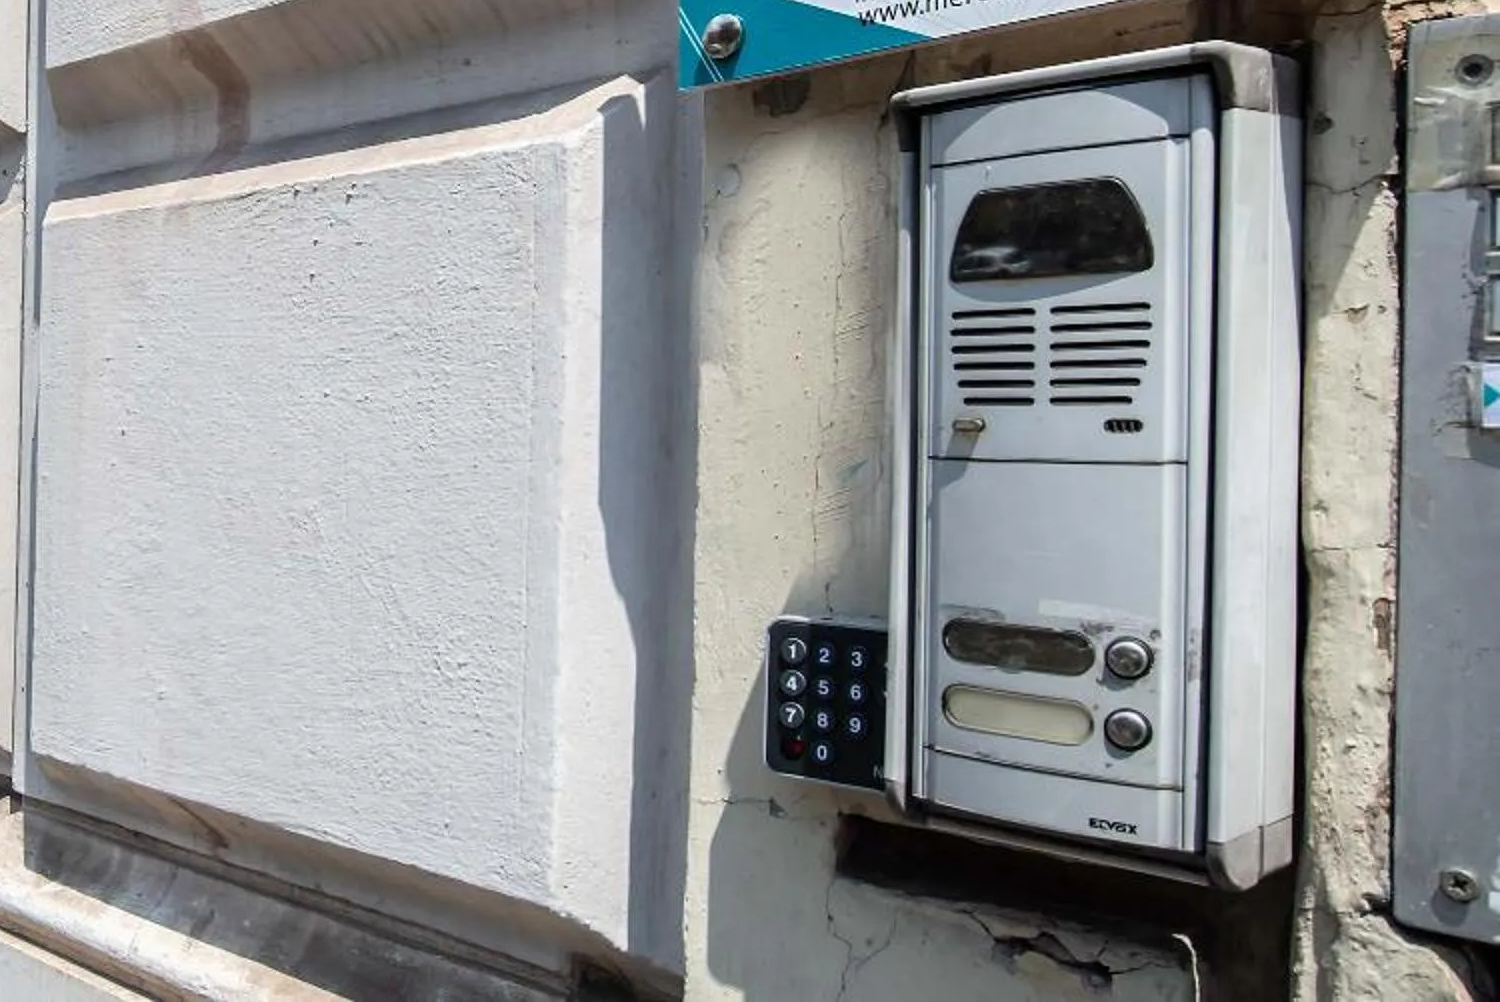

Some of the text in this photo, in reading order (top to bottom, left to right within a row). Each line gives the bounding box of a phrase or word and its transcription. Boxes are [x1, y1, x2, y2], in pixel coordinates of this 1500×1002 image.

[787, 644, 862, 667] 1 2 3
[786, 675, 861, 700] 4 5 6
[785, 707, 861, 733] 7 8 9
[816, 745, 828, 760] 0
